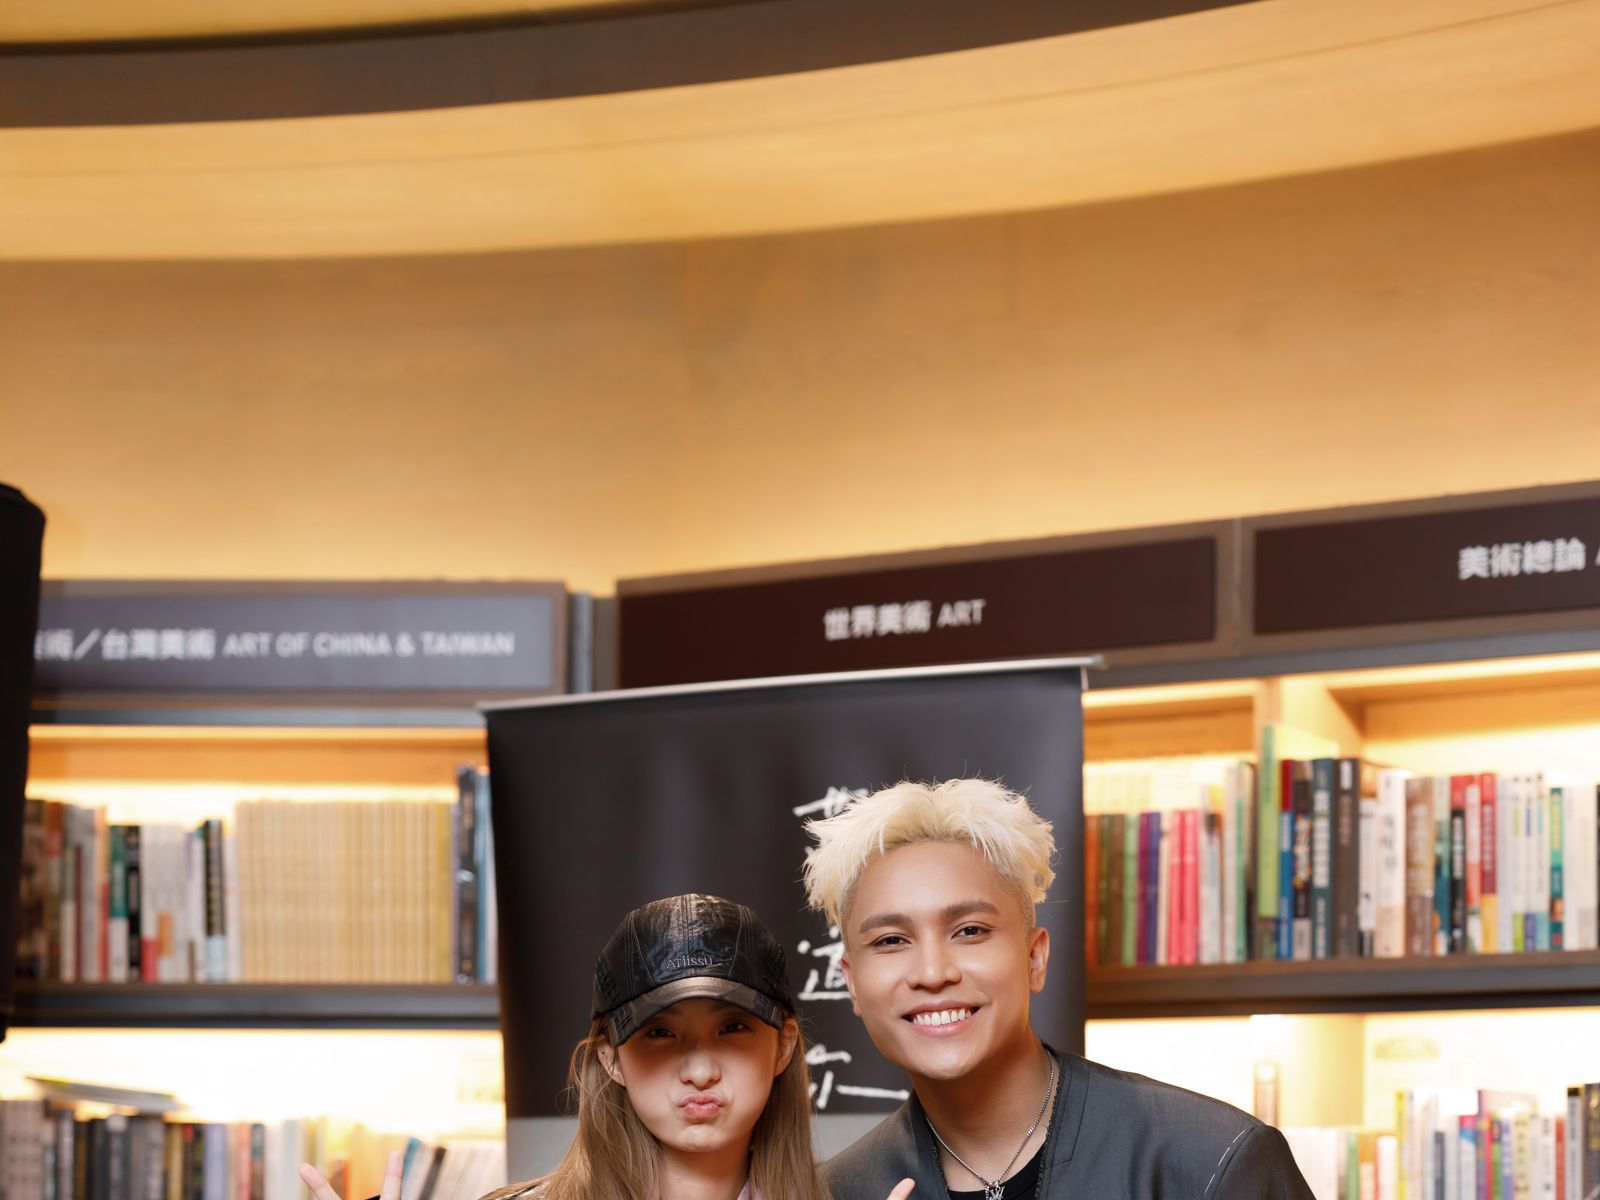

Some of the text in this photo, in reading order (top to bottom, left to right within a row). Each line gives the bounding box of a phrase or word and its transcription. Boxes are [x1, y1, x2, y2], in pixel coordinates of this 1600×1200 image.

[823, 600, 931, 641] 世界美術
[936, 599, 985, 628] ART
[222, 631, 515, 658] ART OF CHINA & TAIWAN
